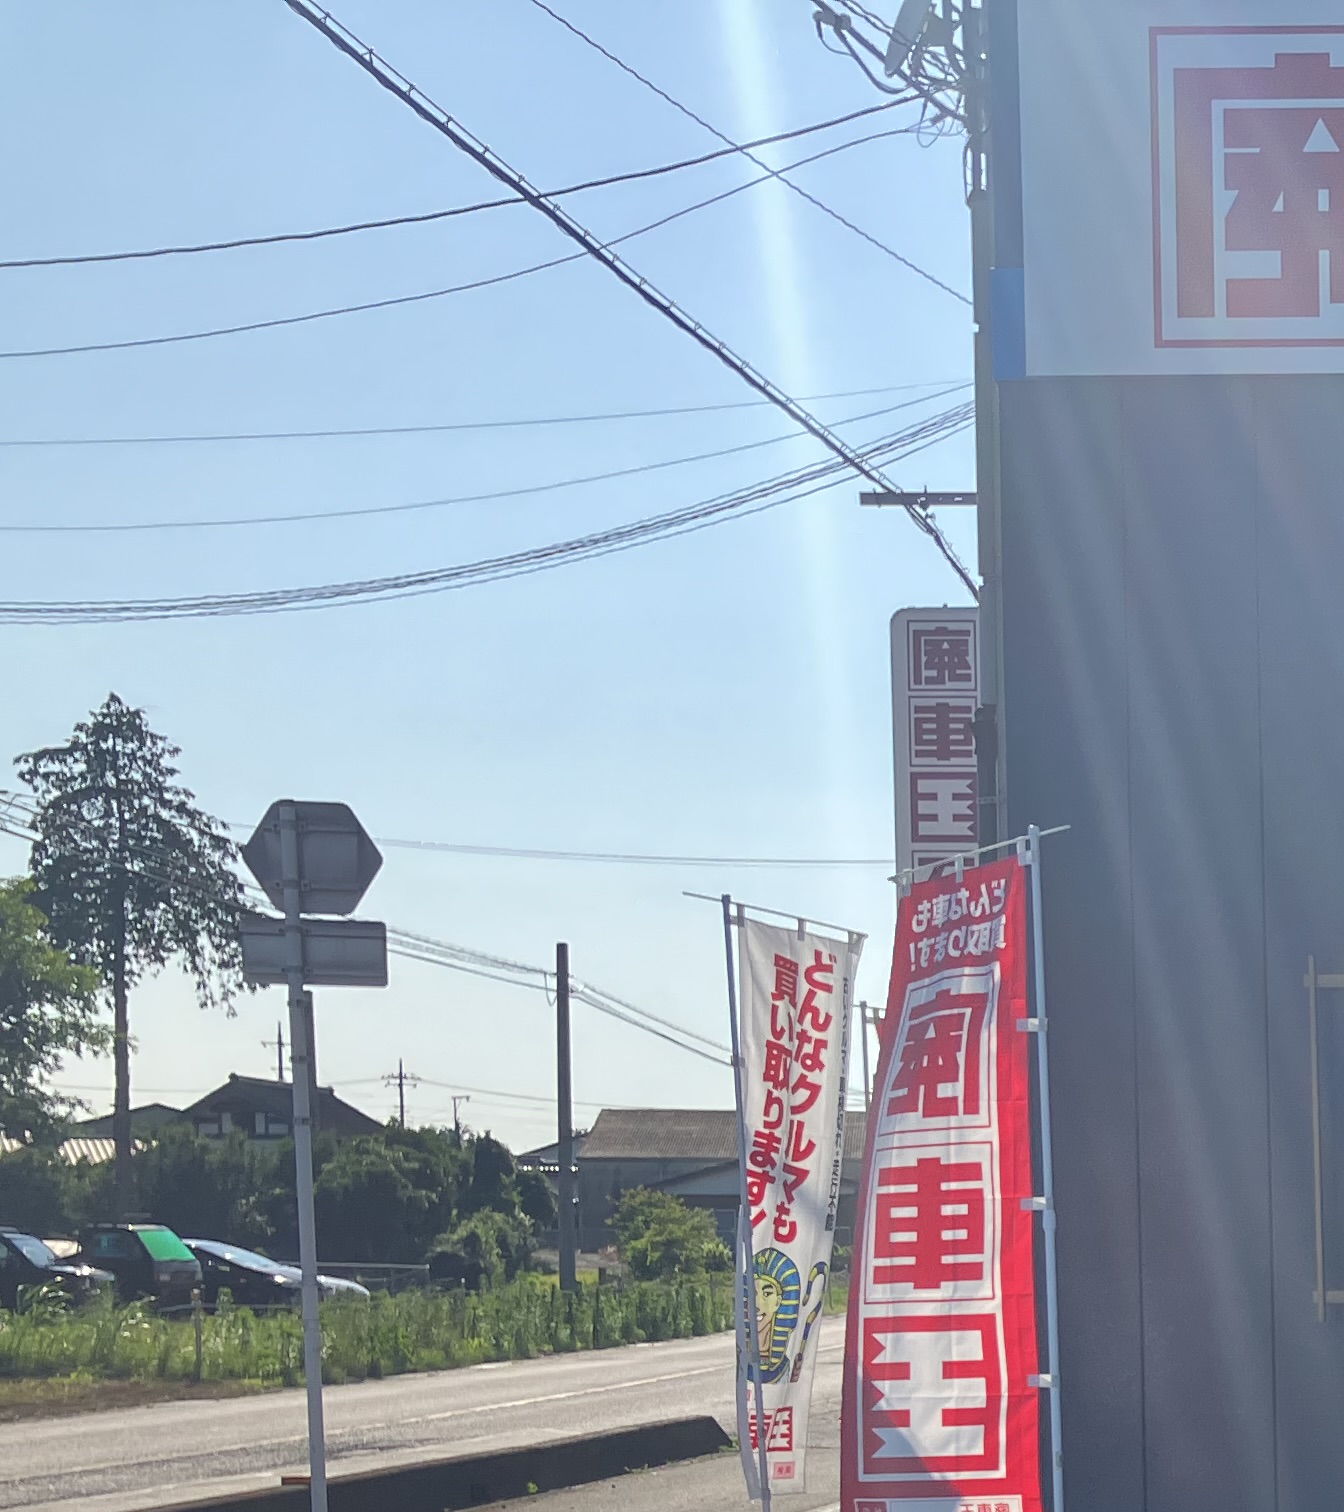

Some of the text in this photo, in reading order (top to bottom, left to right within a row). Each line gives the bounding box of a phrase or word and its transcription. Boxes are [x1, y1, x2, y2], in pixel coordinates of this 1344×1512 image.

[909, 624, 979, 882] 廃車王
[773, 948, 838, 1244] どんなクルマも
